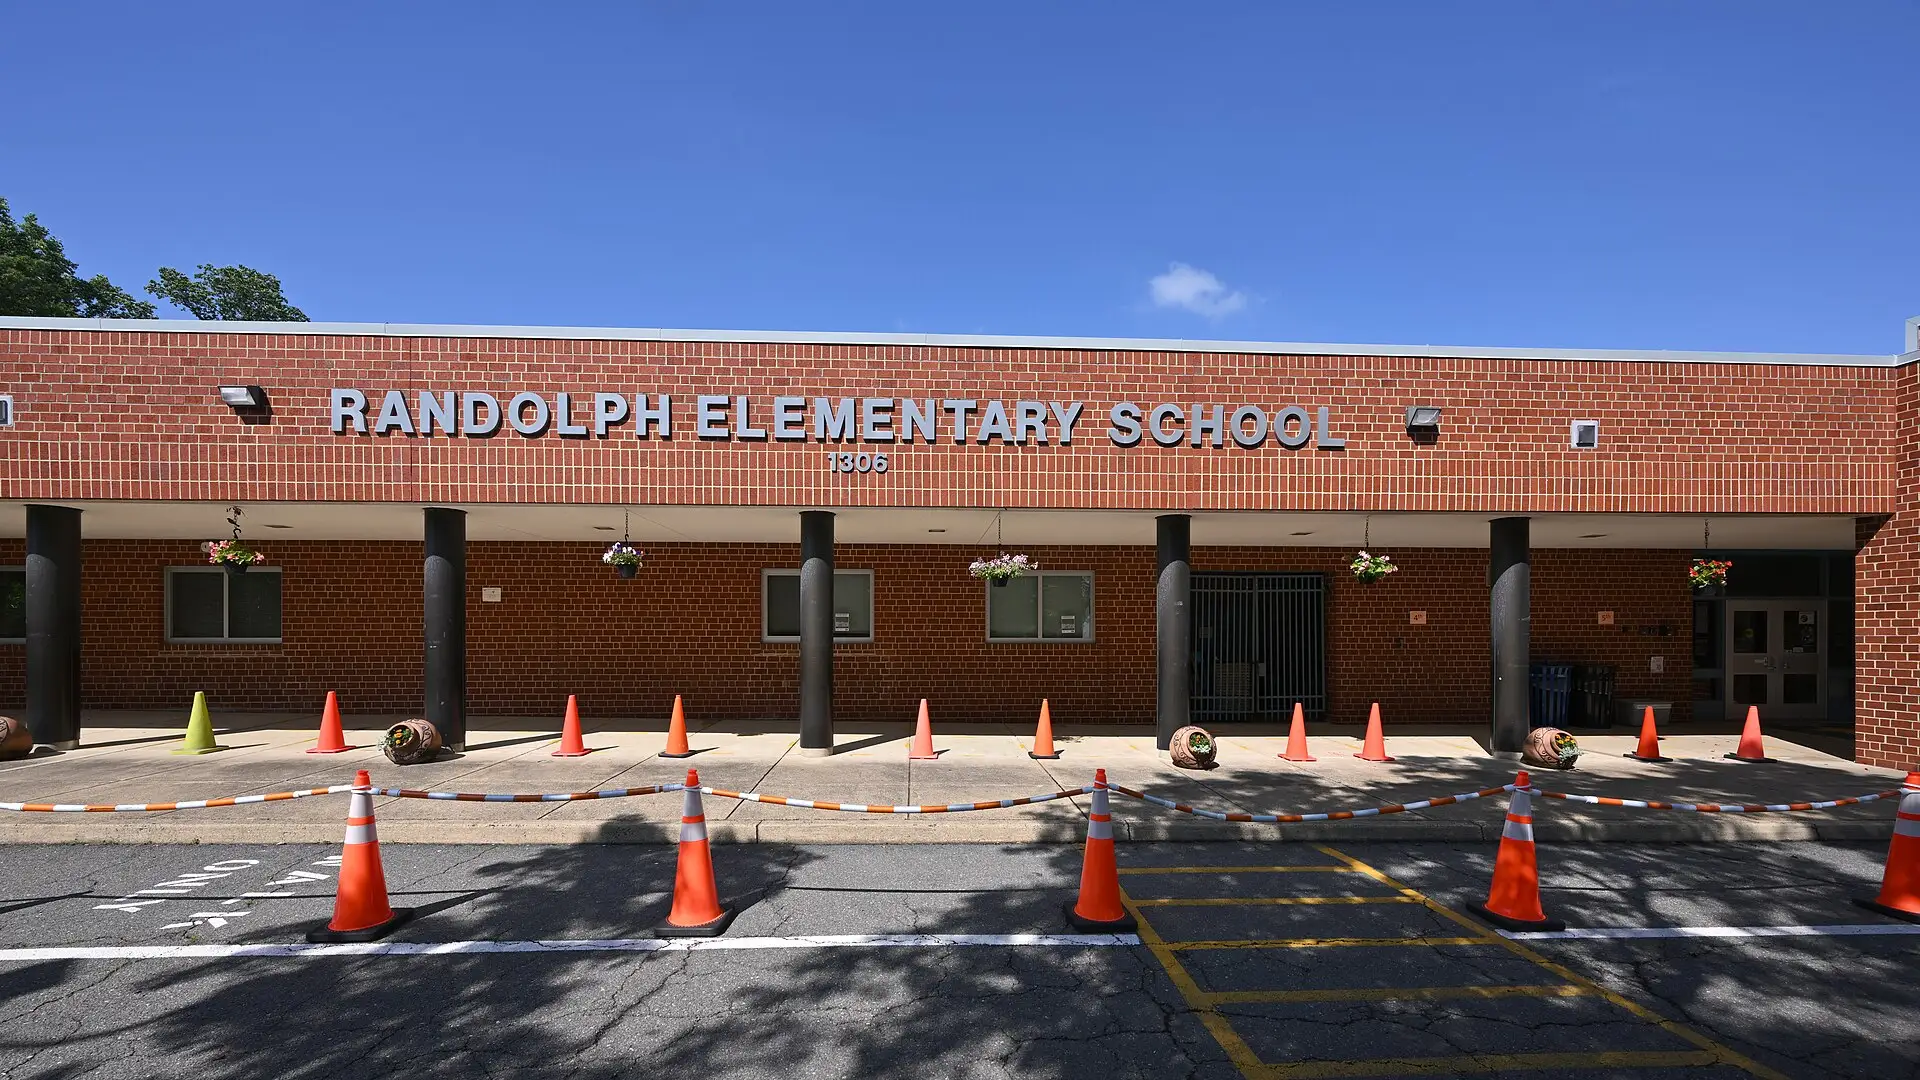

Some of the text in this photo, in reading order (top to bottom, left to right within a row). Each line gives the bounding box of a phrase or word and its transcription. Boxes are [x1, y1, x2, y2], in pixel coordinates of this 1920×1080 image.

[330, 388, 1346, 450] RANDOLPH ELEMENTARY SCHOOL
[827, 451, 888, 474] 1306
[92, 859, 260, 912] ONLY
